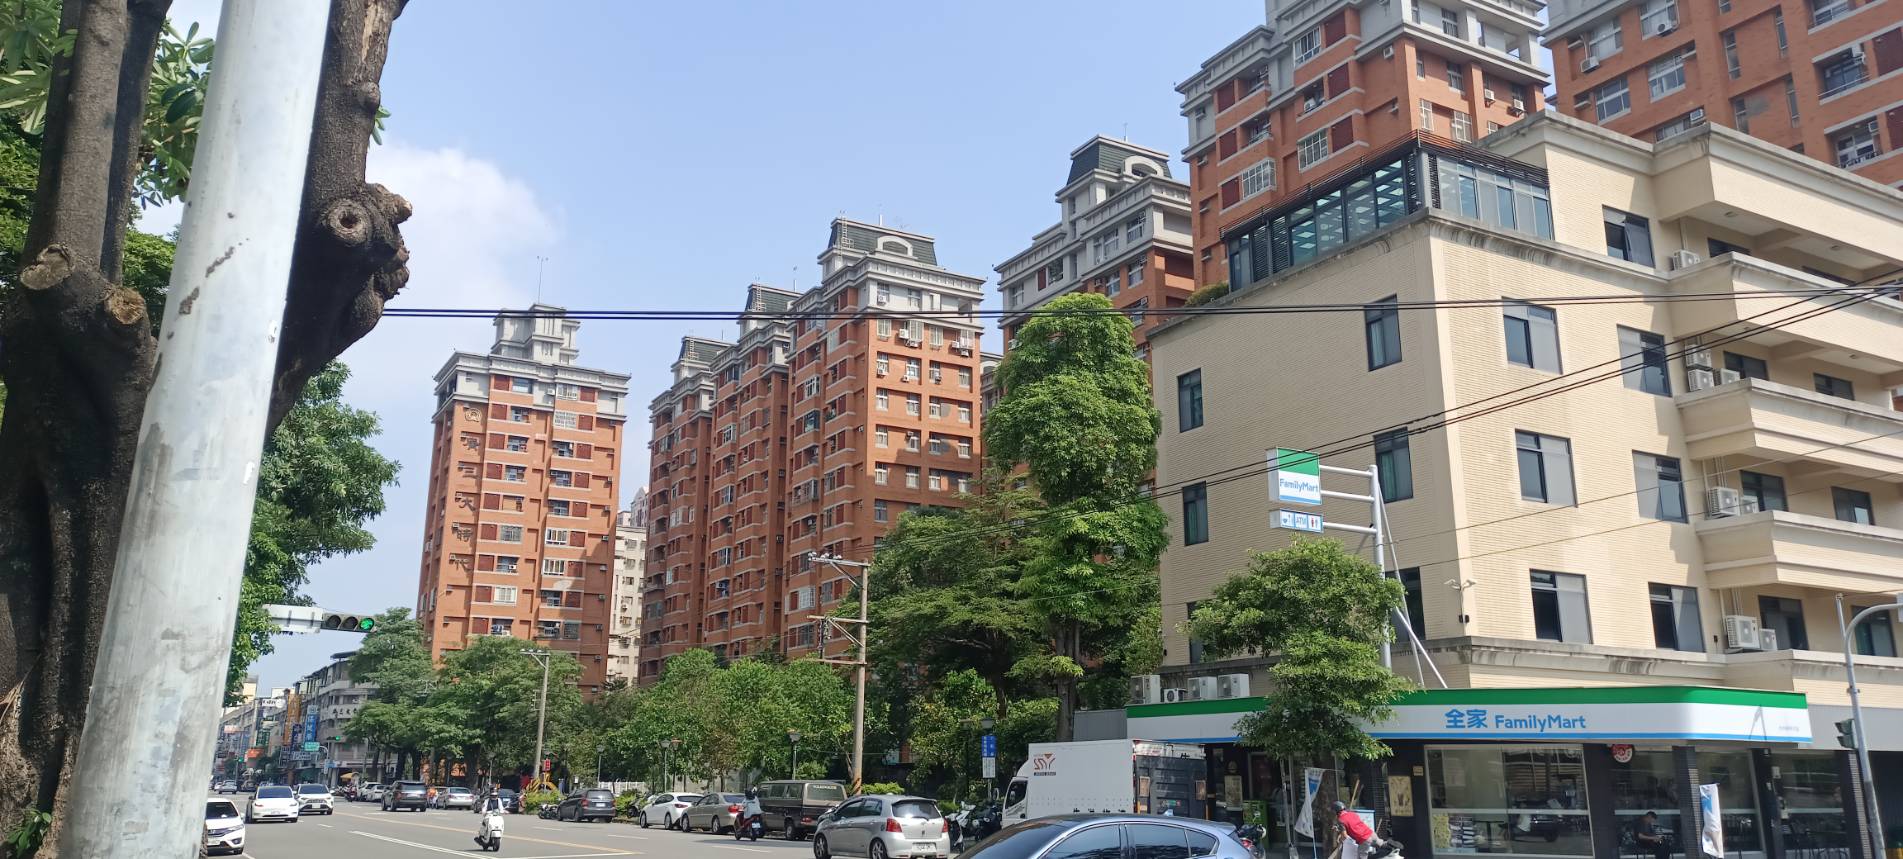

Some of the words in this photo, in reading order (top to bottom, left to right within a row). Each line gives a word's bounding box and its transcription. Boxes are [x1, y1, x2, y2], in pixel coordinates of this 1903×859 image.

[1280, 478, 1319, 493] FamilyMart
[1445, 709, 1488, 729] 全家
[1495, 715, 1586, 732] FamilyMart
